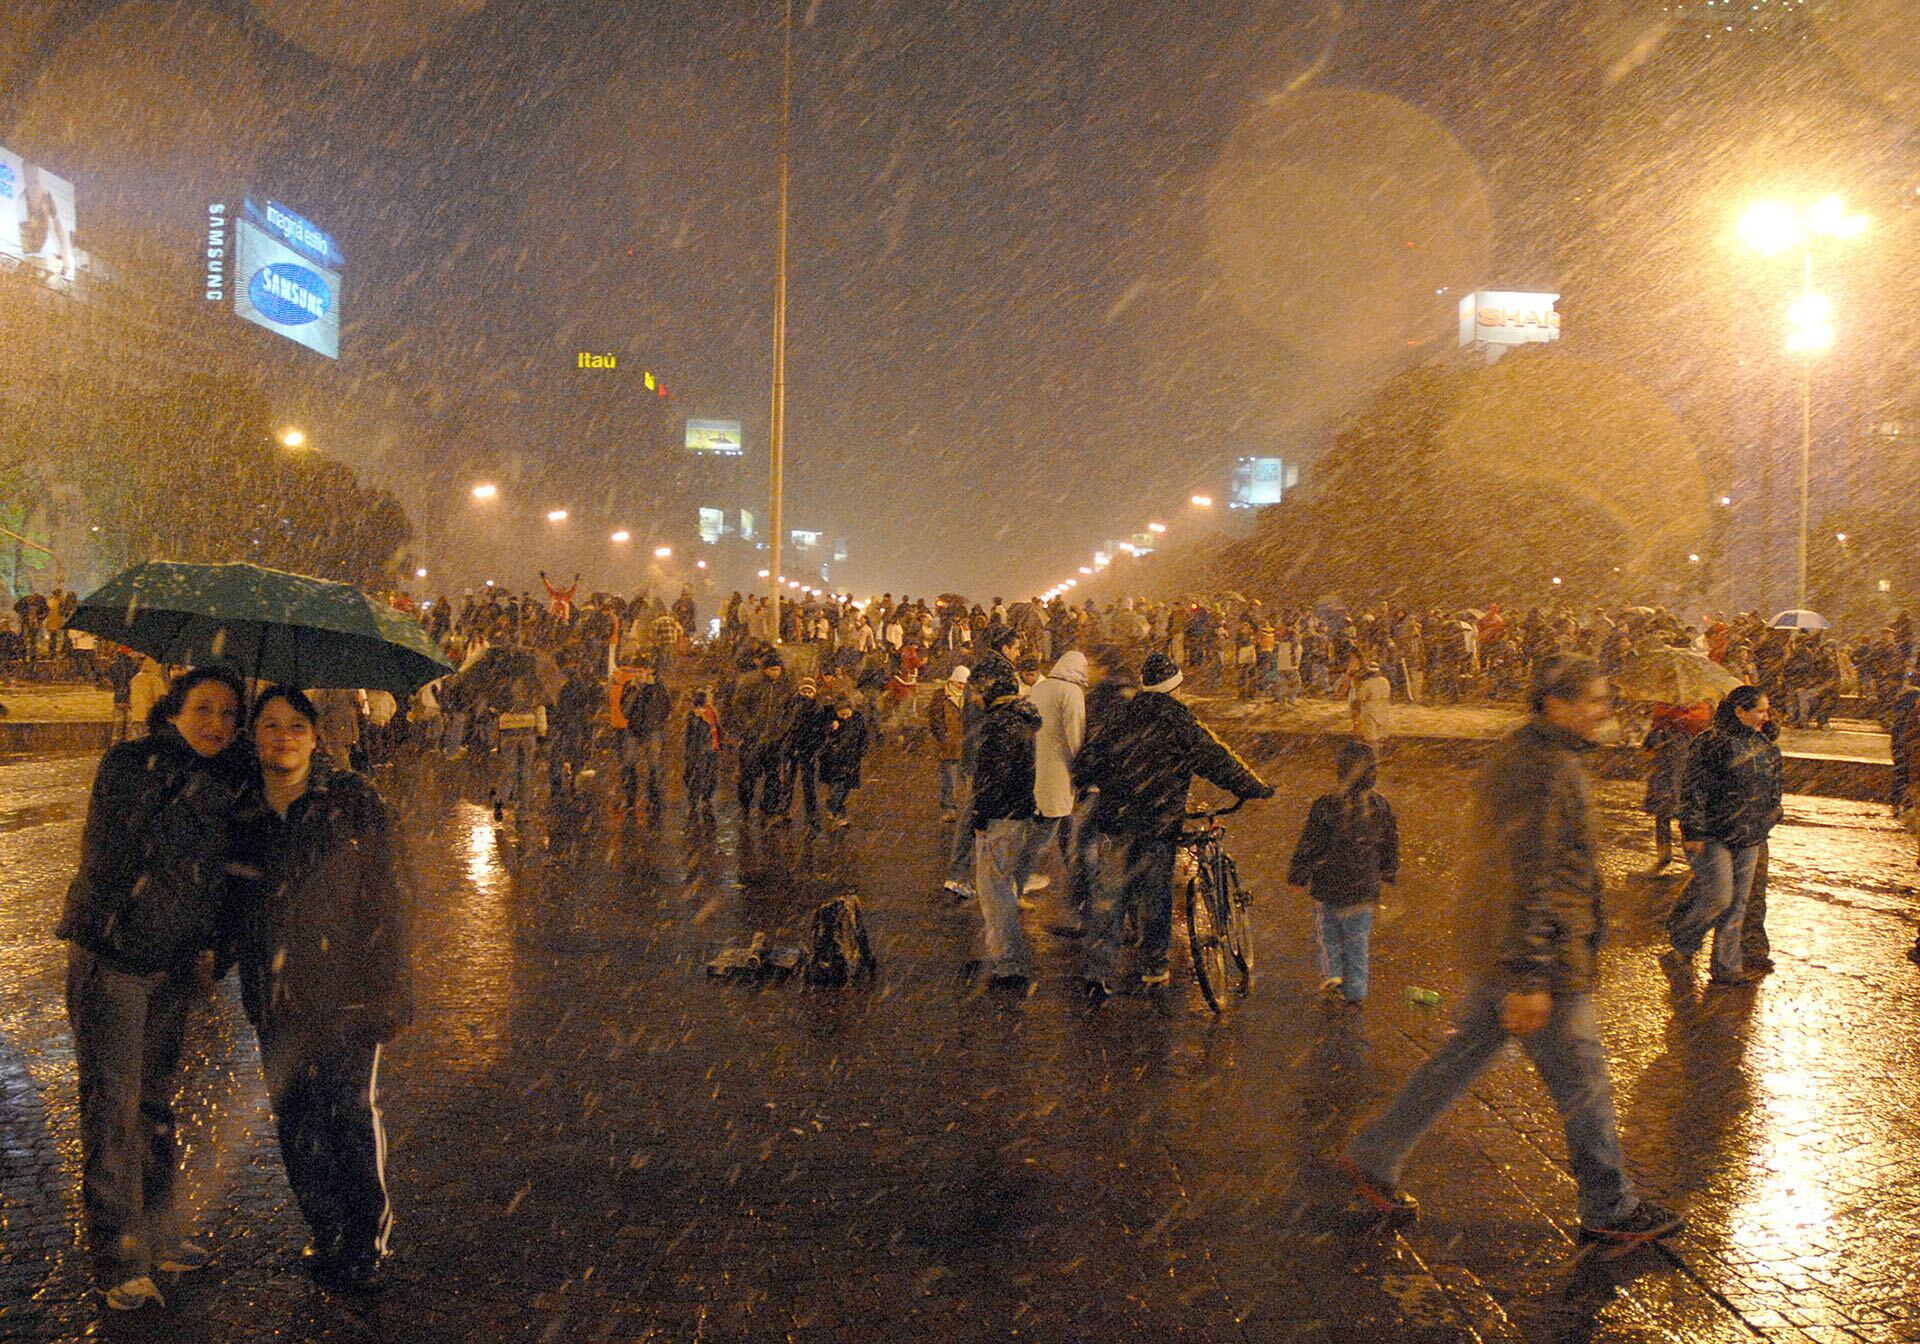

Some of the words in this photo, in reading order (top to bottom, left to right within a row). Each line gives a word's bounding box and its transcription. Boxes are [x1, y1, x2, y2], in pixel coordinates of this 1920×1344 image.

[206, 203, 225, 300] SAMSUNG
[262, 268, 324, 318] SAMSUNG
[578, 352, 616, 369] Itaú
